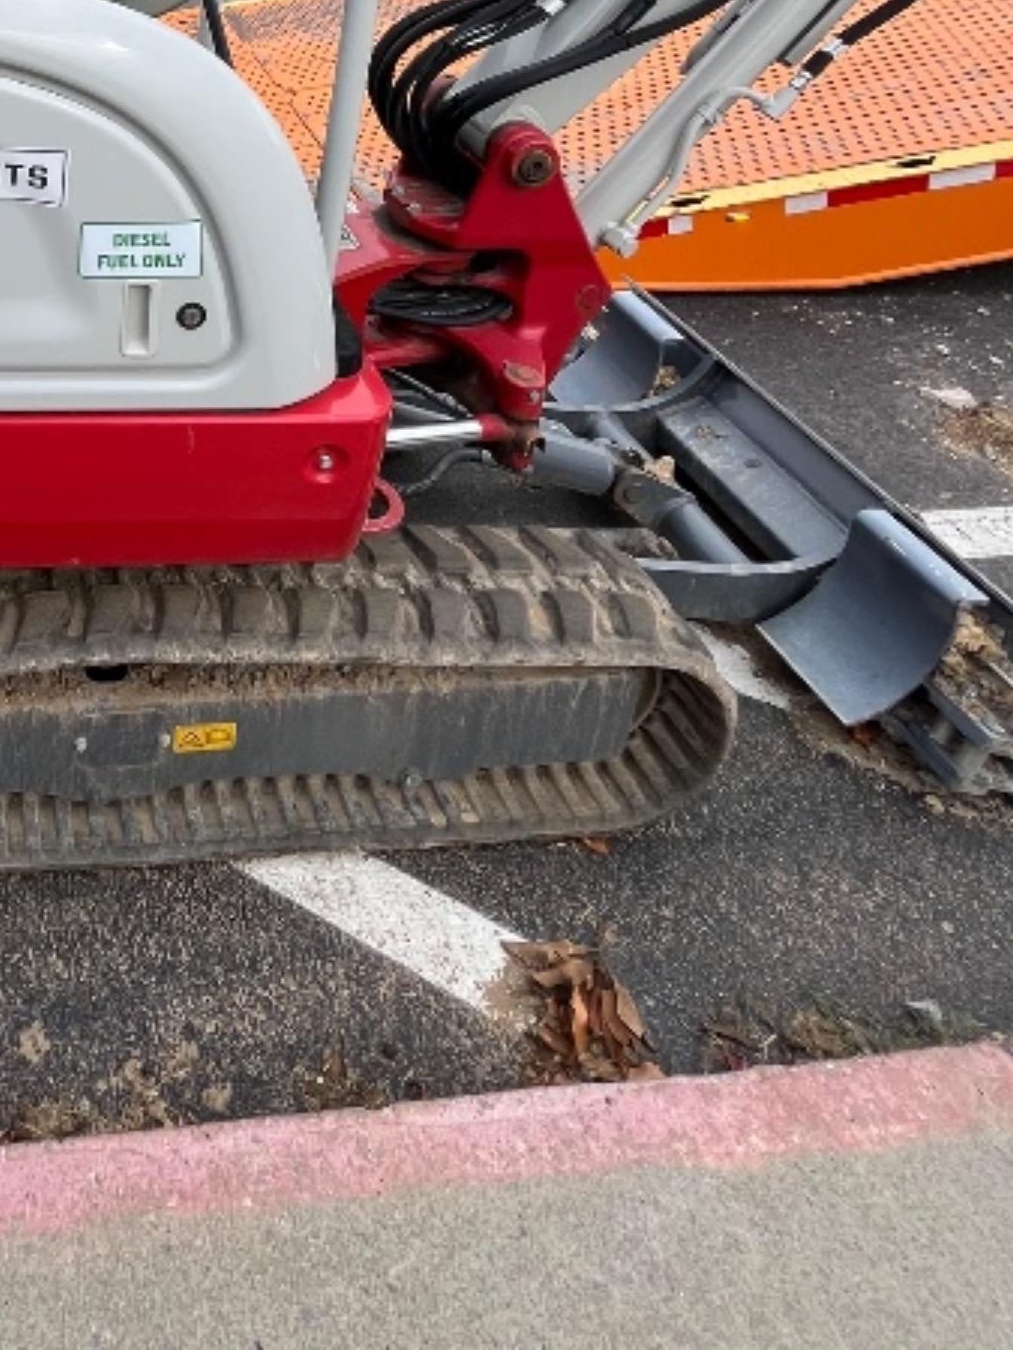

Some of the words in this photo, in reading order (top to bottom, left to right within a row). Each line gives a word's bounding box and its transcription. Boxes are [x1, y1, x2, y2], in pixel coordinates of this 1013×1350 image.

[112, 233, 171, 248] DIESEL
[97, 254, 139, 270] FUEL
[142, 254, 186, 269] ONLY
